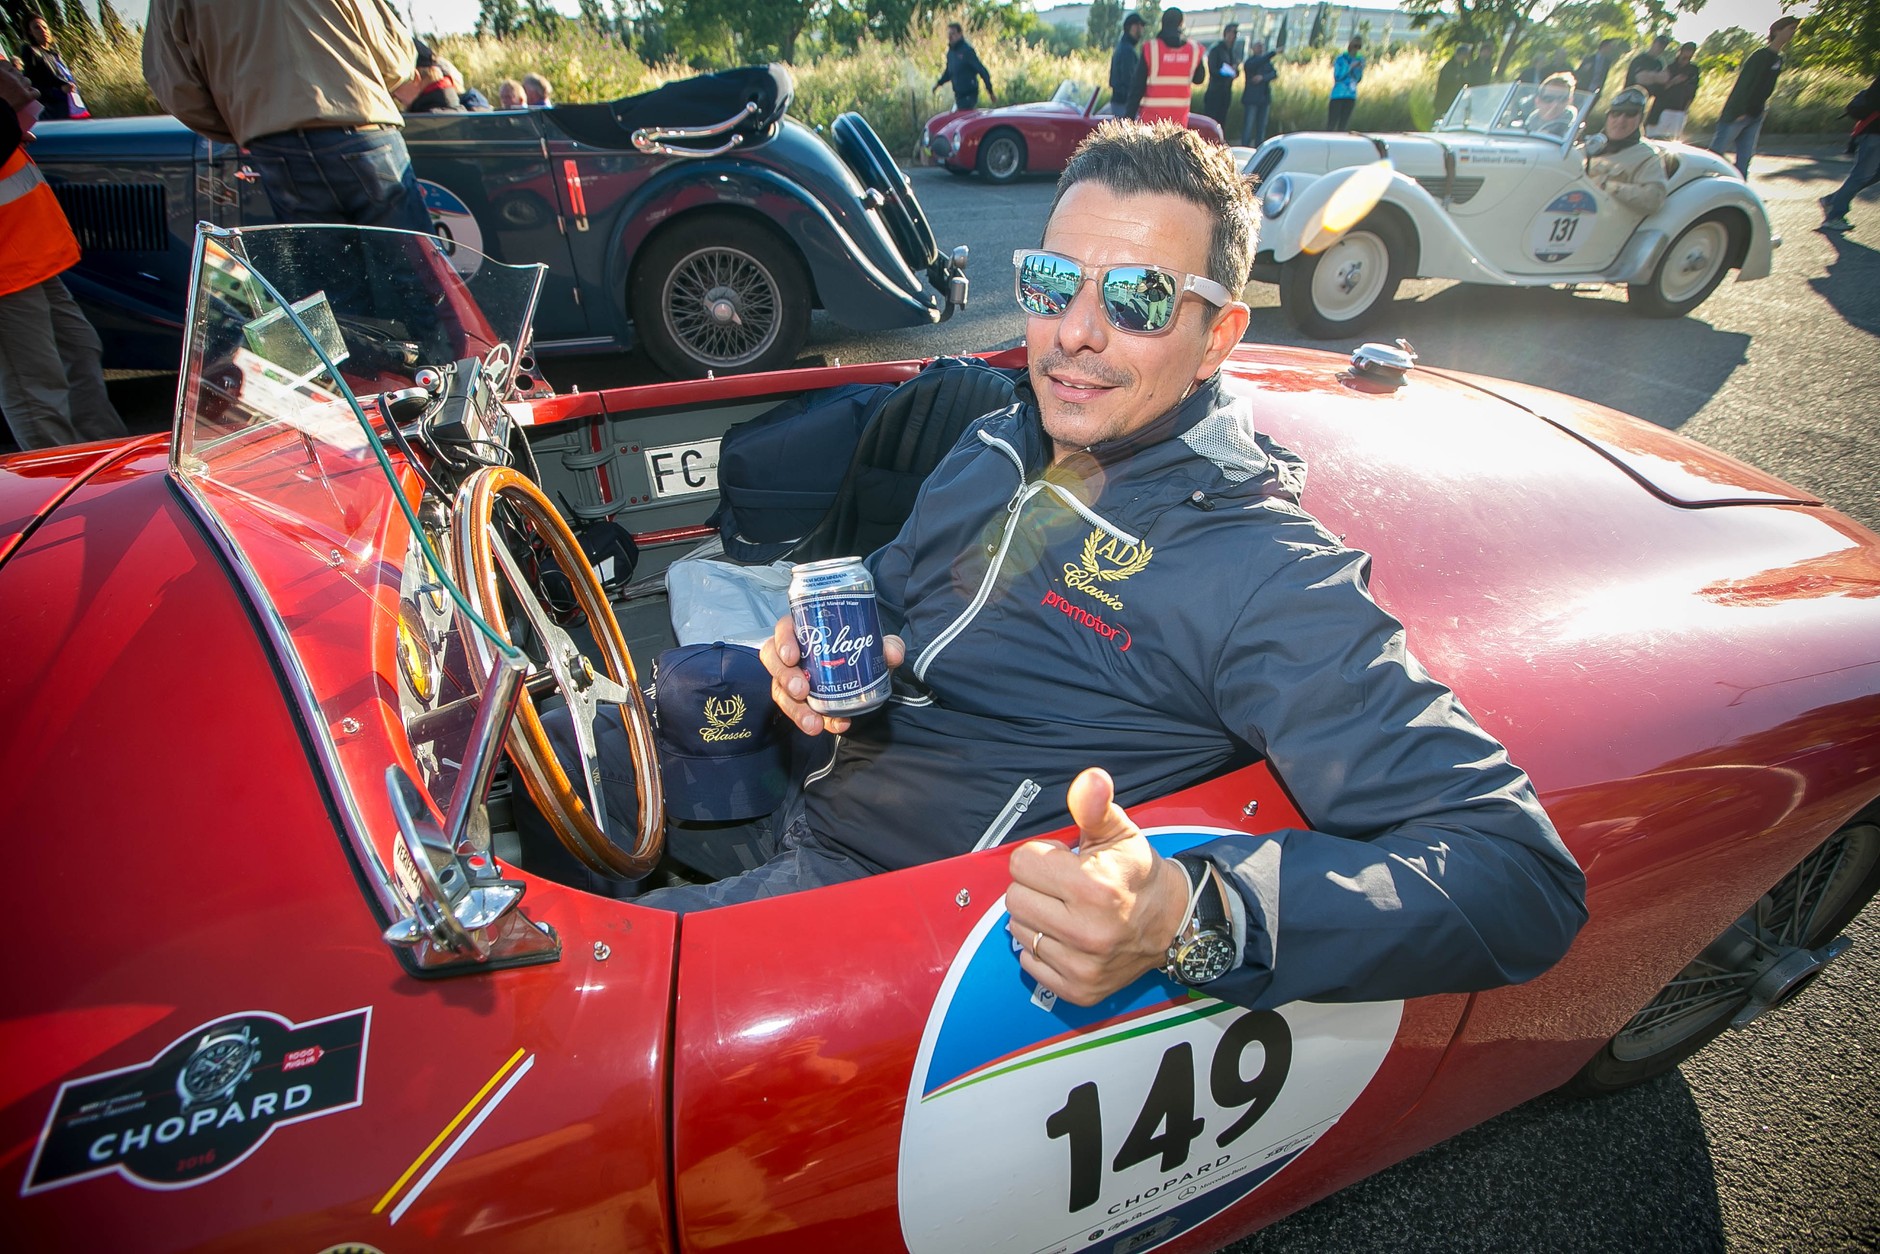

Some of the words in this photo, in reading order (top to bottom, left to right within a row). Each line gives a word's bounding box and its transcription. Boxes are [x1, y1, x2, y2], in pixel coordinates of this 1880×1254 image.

[1548, 217, 1580, 242] 131
[650, 449, 707, 493] FC
[1095, 538, 1140, 567] AD
[1062, 562, 1125, 612] Classic
[1040, 589, 1121, 642] promotor
[797, 625, 875, 667] Perlage
[816, 683, 842, 692] GENTLE
[842, 680, 860, 690] FIZZ
[713, 699, 737, 717] AD
[699, 726, 753, 743] Classic
[288, 1047, 316, 1061] 1000
[87, 1083, 313, 1162] CHOPARD
[1045, 1008, 1293, 1214] 149
[176, 1149, 216, 1173] 2016
[1107, 1154, 1232, 1215] CHOPARD
[1199, 1165, 1248, 1190] Mercedes-Benz
[1128, 1227, 1157, 1249] 2016
